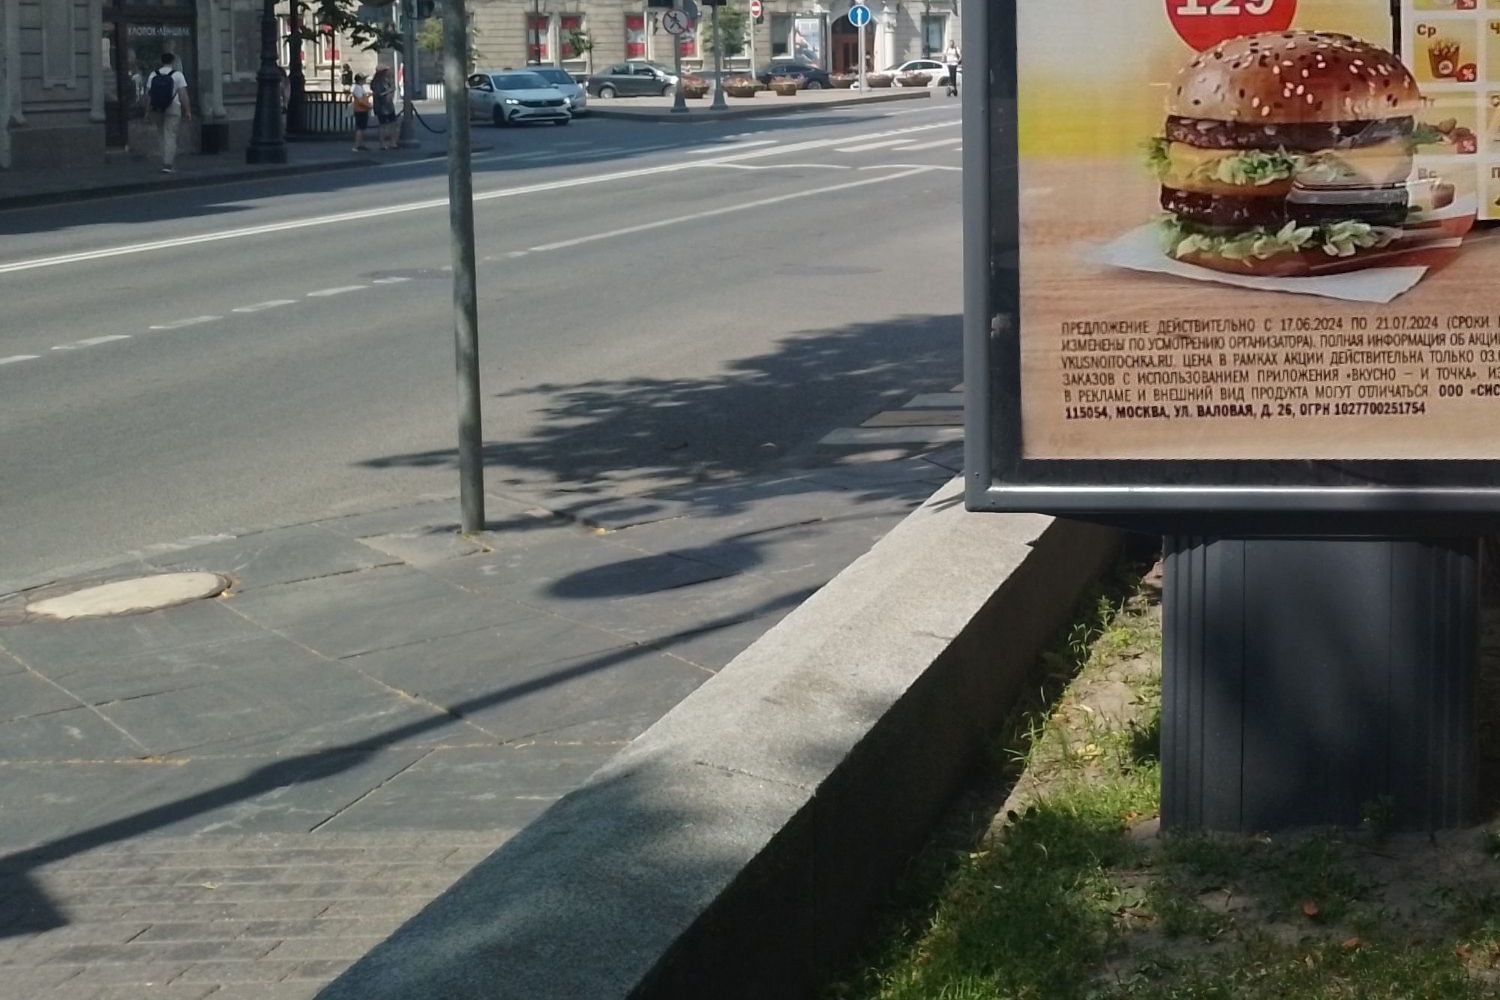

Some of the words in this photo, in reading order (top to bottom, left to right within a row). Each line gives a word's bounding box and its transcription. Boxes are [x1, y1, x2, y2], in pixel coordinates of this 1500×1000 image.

[1416, 23, 1437, 36] Ср
[1061, 319, 1150, 335] ПРЕДЛОЖЕНИЕ
[1156, 318, 1256, 334] ДЕЙСТВИТЕЛЬНО
[1263, 317, 1273, 333] С
[1280, 316, 1344, 332] 17.06.2024
[1350, 315, 1368, 331] ПО
[1375, 315, 1439, 331] 21.07.2024
[1446, 314, 1490, 330] (СРОКИ
[1060, 336, 1125, 352] ИЗМЕНЕНЫ
[1128, 336, 1146, 352] ПО
[1147, 335, 1226, 351] УСМОТРЕНИЮ
[1228, 334, 1316, 350] ОРГАНИЗАТОРА).
[1319, 333, 1364, 349] ПОЛНАЯ
[1367, 332, 1447, 348] ИНФОРМАЦИЯ
[1449, 331, 1466, 347] ОБ
[1182, 352, 1213, 368] ЦЕНА
[1218, 351, 1227, 367] В
[1232, 351, 1278, 367] РАМКАХ
[1283, 350, 1324, 366] АКЦИИ
[1329, 349, 1424, 365] ДЕЙСТВИТЕЛЬНА
[1428, 348, 1474, 364] ТОЛЬКО
[1062, 370, 1116, 386] ЗАКАЗОВ
[1122, 370, 1131, 386] С
[1137, 369, 1250, 385] ИСПОЛЬЗОВАНИЕМ
[1257, 367, 1339, 383] ПРИЛОЖЕНИЯ
[1420, 365, 1430, 381] И
[1063, 388, 1072, 404] В
[1078, 387, 1132, 403] РЕКЛАМЕ
[1137, 387, 1147, 403] И
[1153, 386, 1213, 402] ВНЕШНИЙ
[1220, 385, 1245, 401] ВИД
[1251, 385, 1309, 401] ПРОДУКТА
[1314, 384, 1352, 400] МОГУТ
[1438, 382, 1464, 398] ООО
[1065, 404, 1112, 421] 115054,
[1115, 403, 1171, 420] МОСКВА,
[1173, 403, 1193, 419] УЛ.
[1196, 402, 1258, 418] ВАЛОВАЯ,
[1277, 401, 1296, 417] 26,
[1299, 401, 1331, 417] ОГРН
